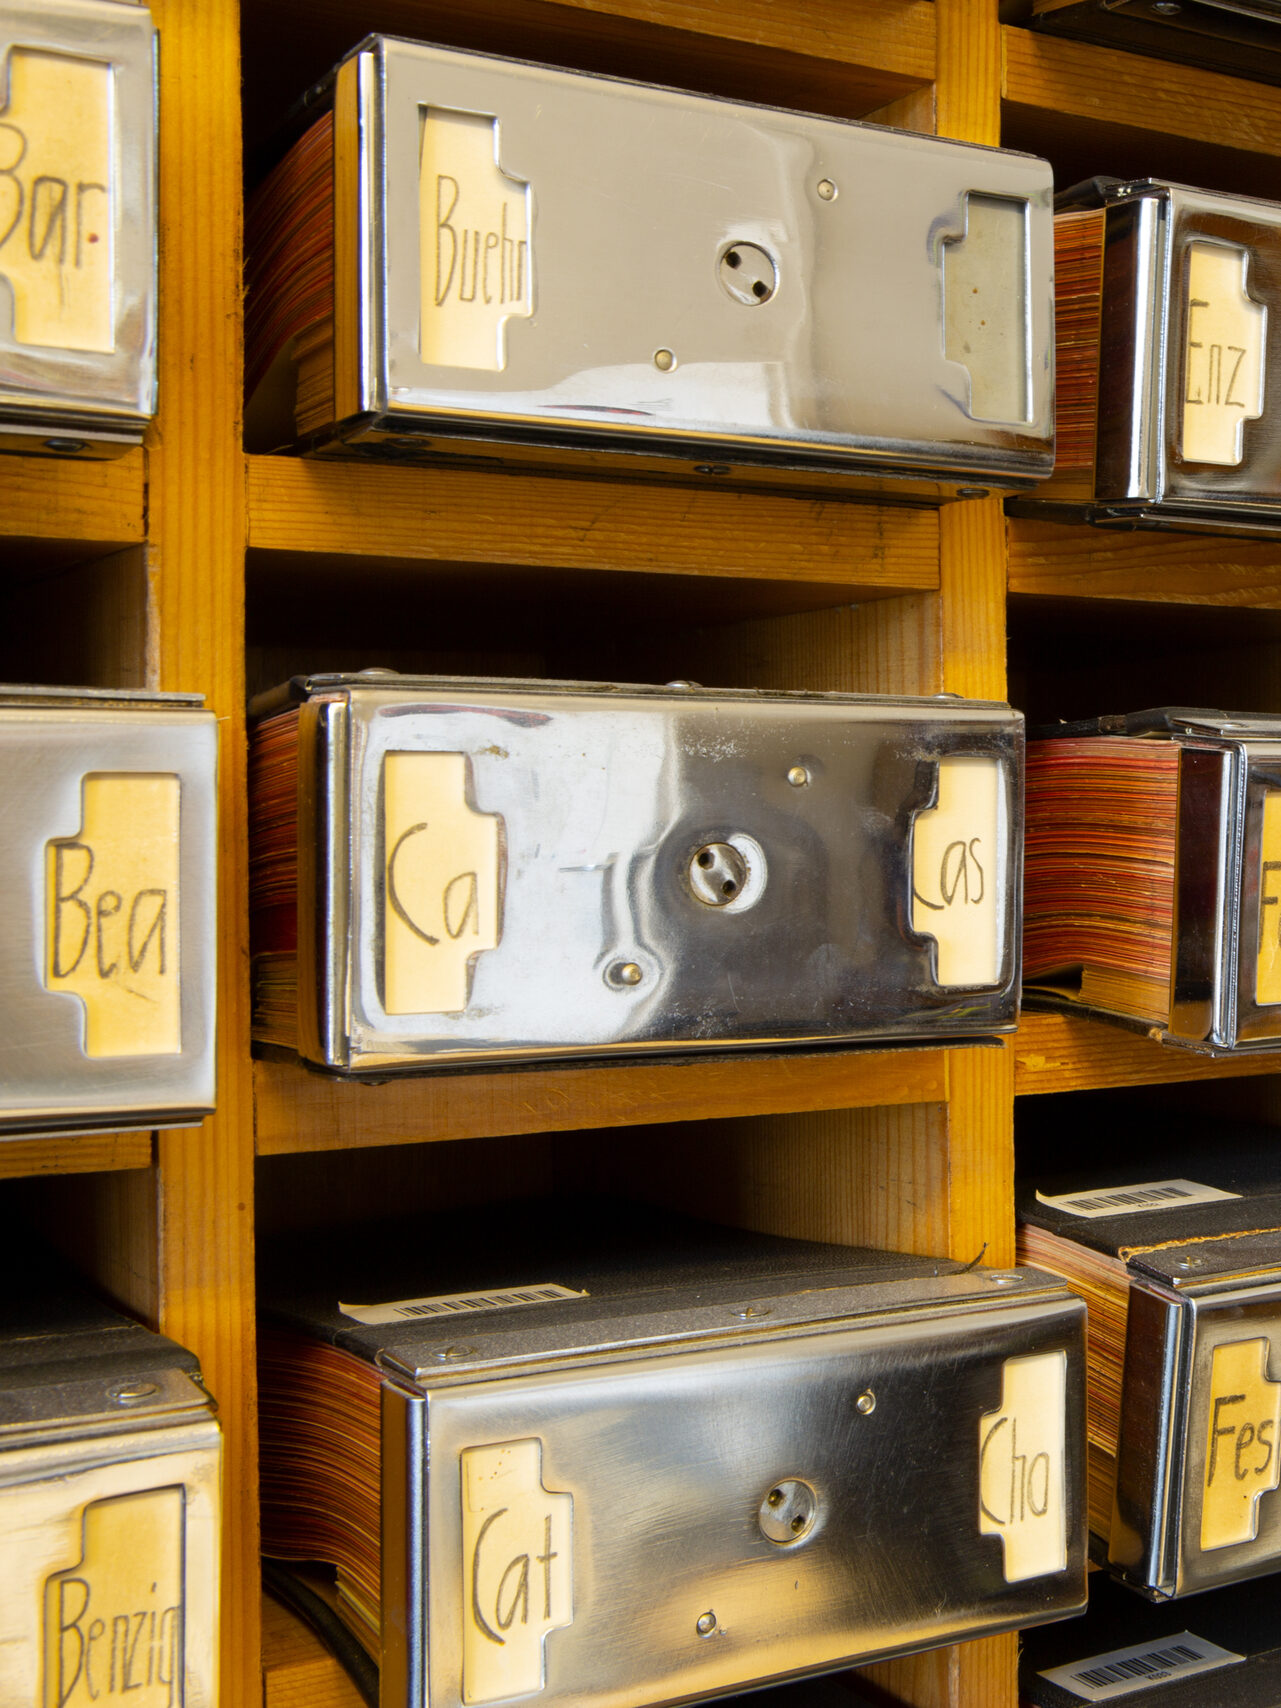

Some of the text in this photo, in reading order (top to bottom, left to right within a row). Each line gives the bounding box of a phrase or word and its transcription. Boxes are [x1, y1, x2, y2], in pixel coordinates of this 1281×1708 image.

[1185, 299, 1247, 408] Enz
[53, 841, 167, 980] Bea
[388, 822, 480, 946] Ca
[1207, 1394, 1274, 1487] Fes
[472, 1508, 558, 1645] Cat
